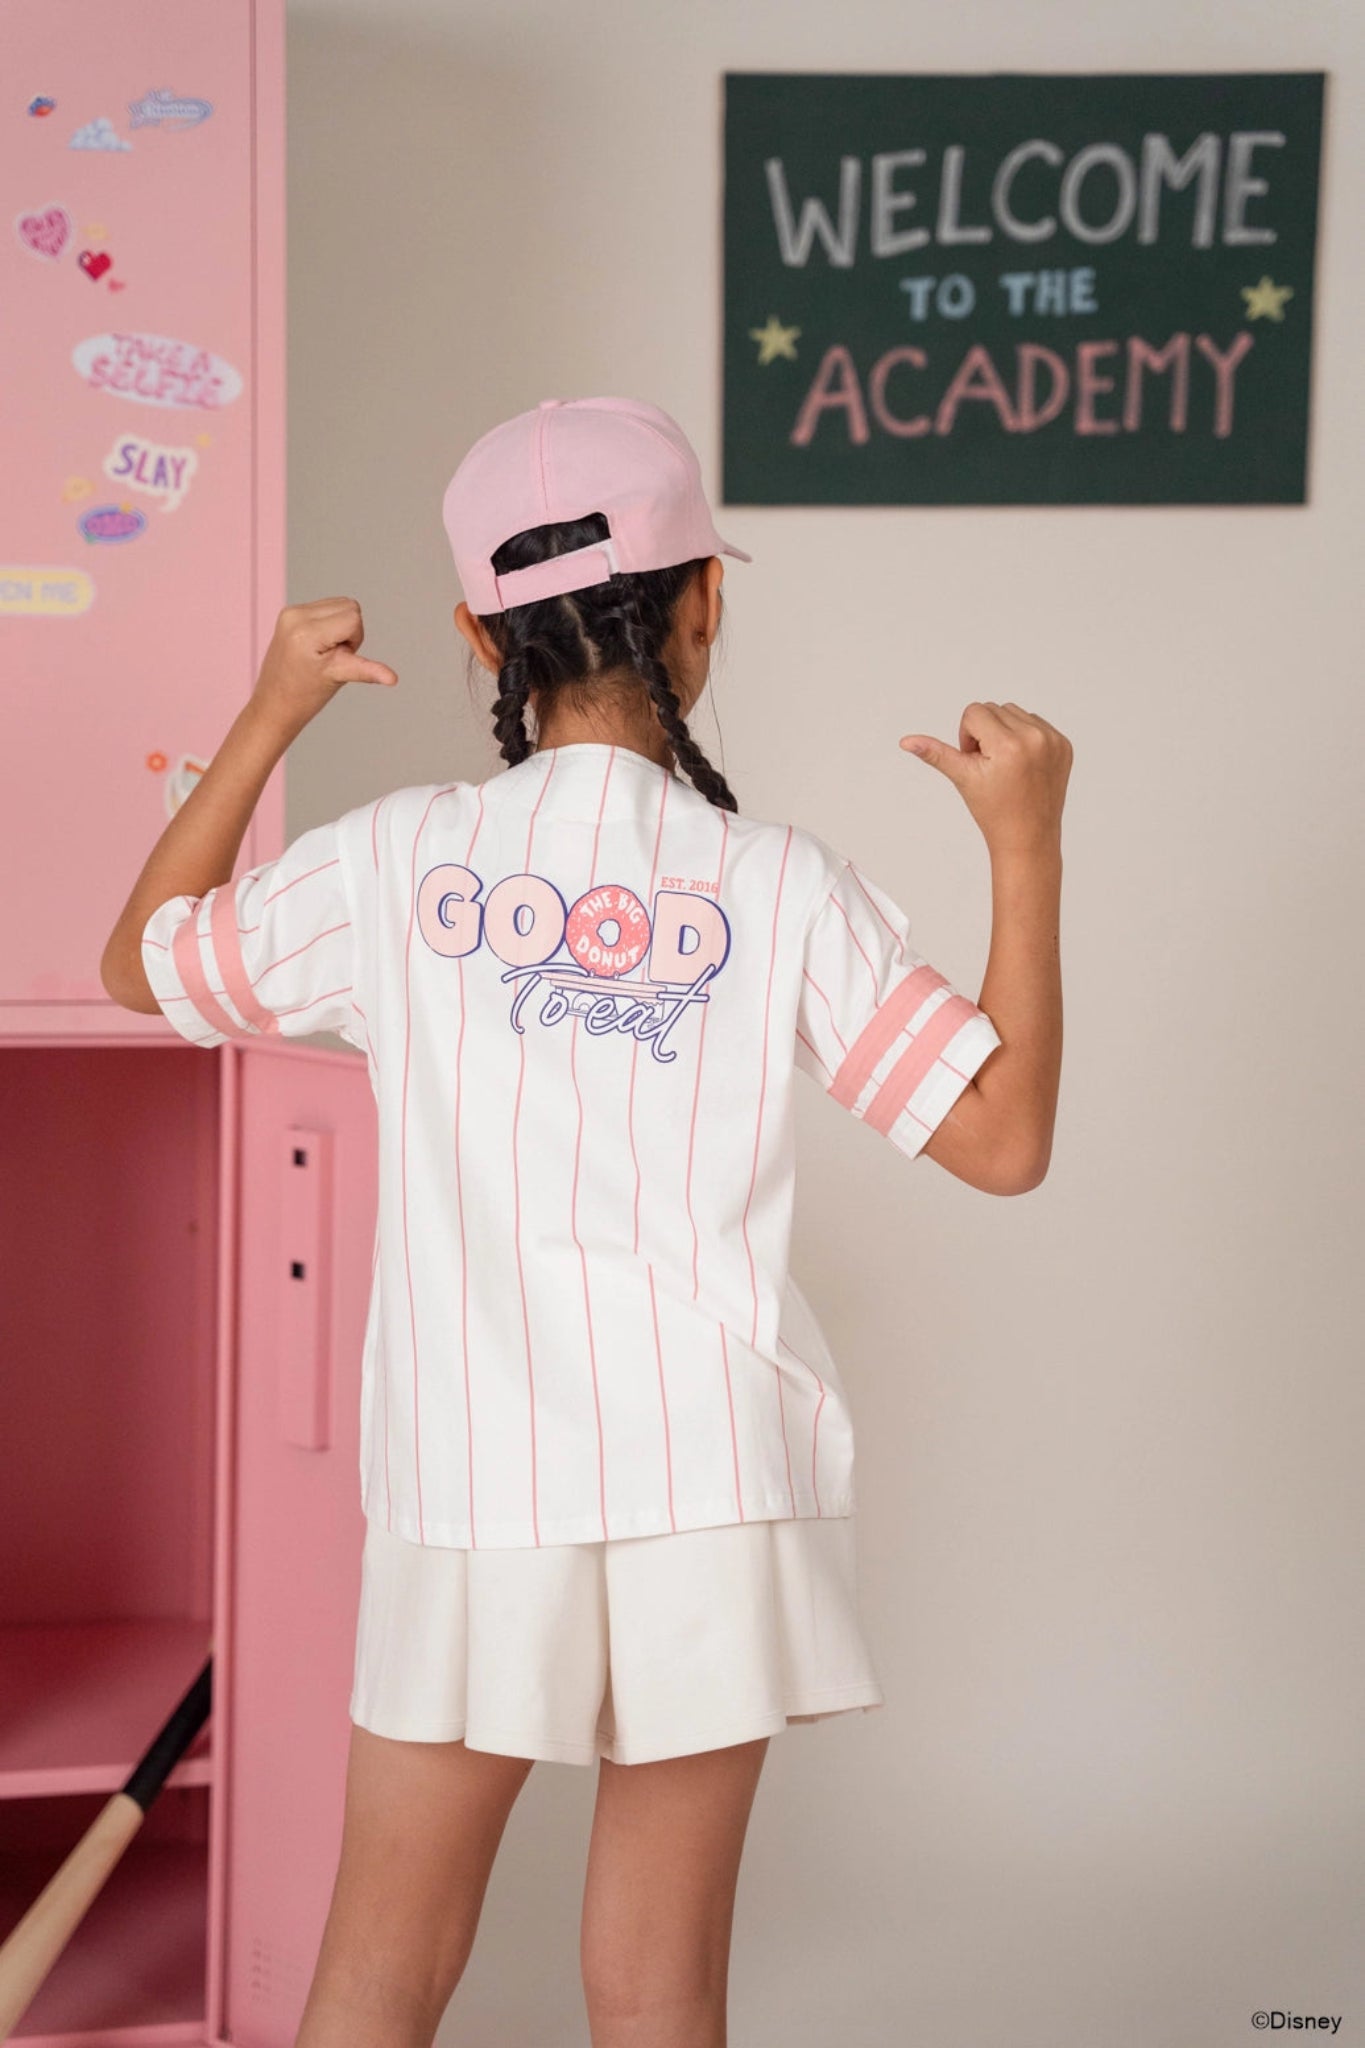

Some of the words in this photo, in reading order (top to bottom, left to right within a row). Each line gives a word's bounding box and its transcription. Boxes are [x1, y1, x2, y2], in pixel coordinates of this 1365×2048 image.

[764, 130, 1287, 268] WELCOME
[900, 273, 976, 321] TO
[1000, 267, 1099, 317] THE
[789, 330, 1255, 447] ACADEMY
[113, 443, 187, 490] SLAY
[580, 891, 613, 918] THE
[618, 892, 643, 924] BIG
[661, 876, 687, 890] EST.
[689, 880, 720, 893] 2016
[417, 863, 731, 986] GOOD
[576, 935, 640, 968] DONUT
